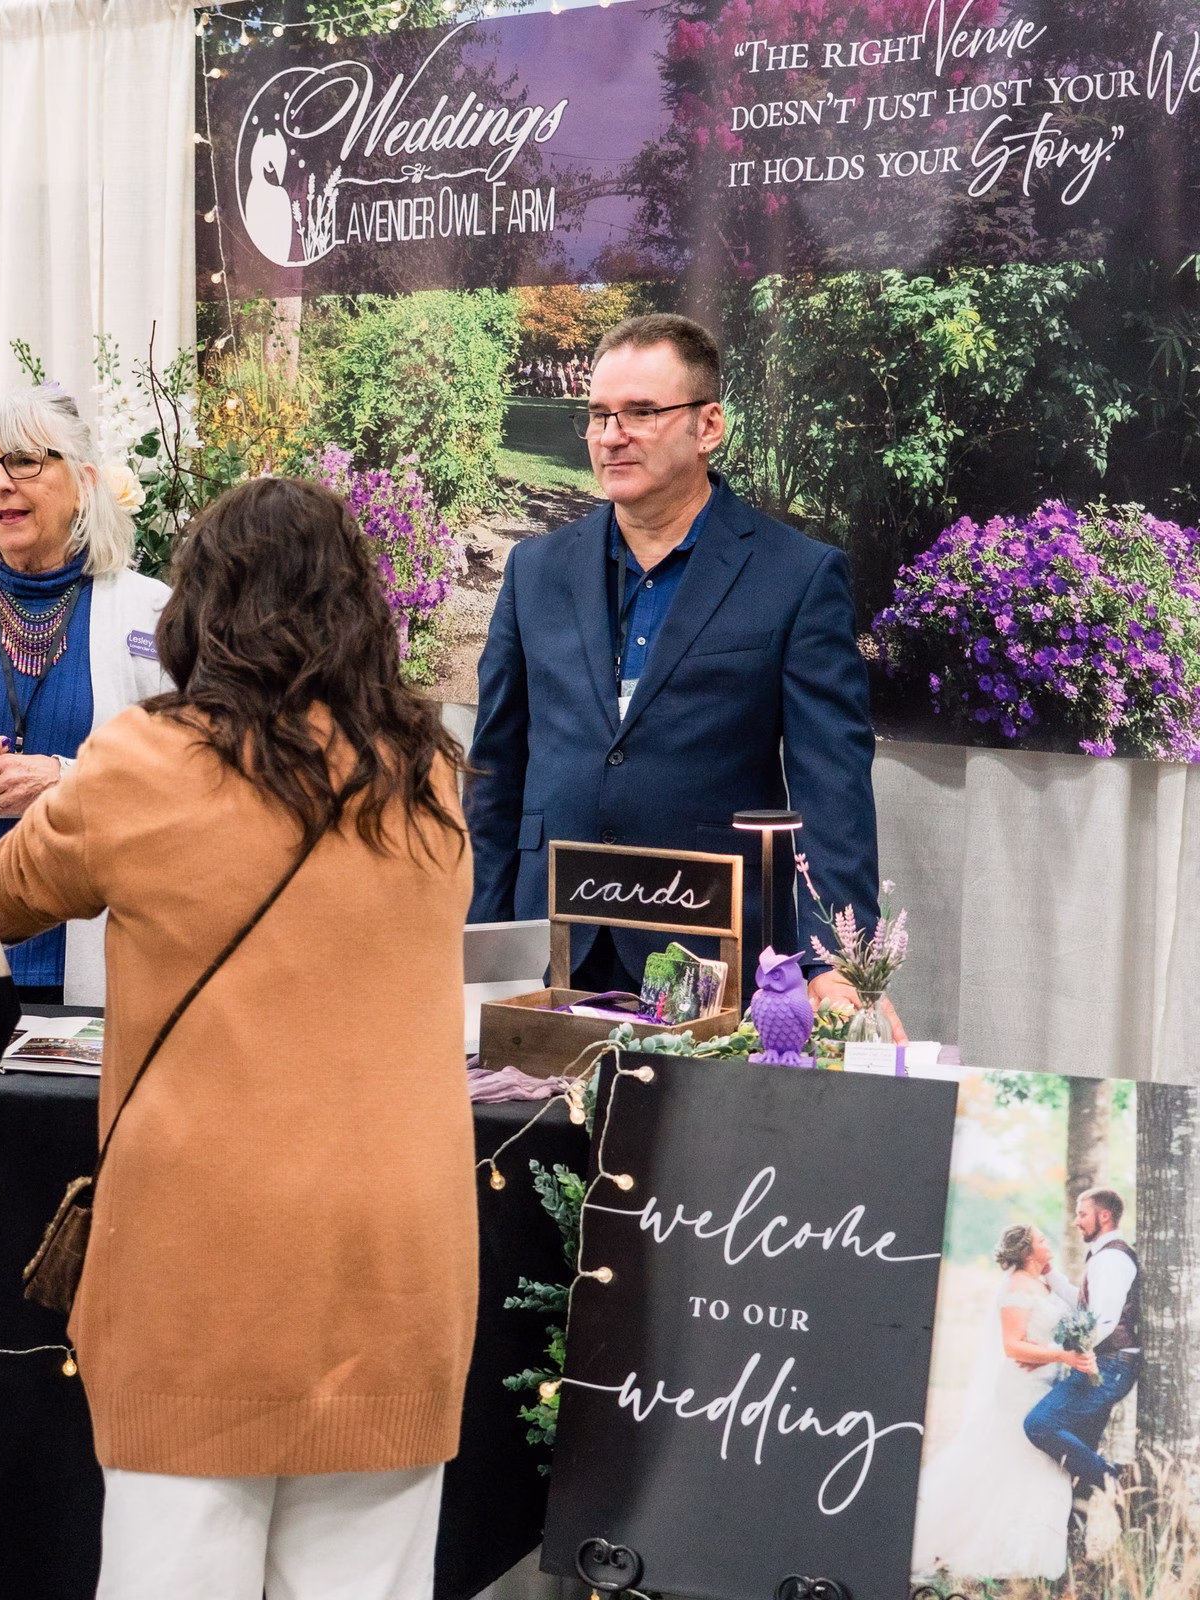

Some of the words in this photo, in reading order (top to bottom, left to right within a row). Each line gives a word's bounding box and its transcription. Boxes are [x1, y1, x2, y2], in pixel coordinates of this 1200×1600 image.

[823, 34, 924, 69] RIGHT
[922, 0, 1048, 77] Venue
[283, 20, 568, 183] Weddings
[730, 93, 855, 131] DOESN’T
[863, 91, 937, 130] JUST
[947, 78, 1032, 112] HOST
[1044, 70, 1140, 103] YOUR
[728, 162, 754, 188] IT
[763, 155, 864, 185] HOLDS
[876, 146, 961, 178] YOUR
[332, 193, 434, 245] LAVENDER
[439, 186, 486, 238] OWL
[492, 182, 555, 235] FARM
[570, 870, 710, 909] cards
[584, 1166, 942, 1266] welcome
[689, 1296, 730, 1321] TO
[743, 1304, 810, 1332] OUR
[561, 1353, 925, 1515] wedding
